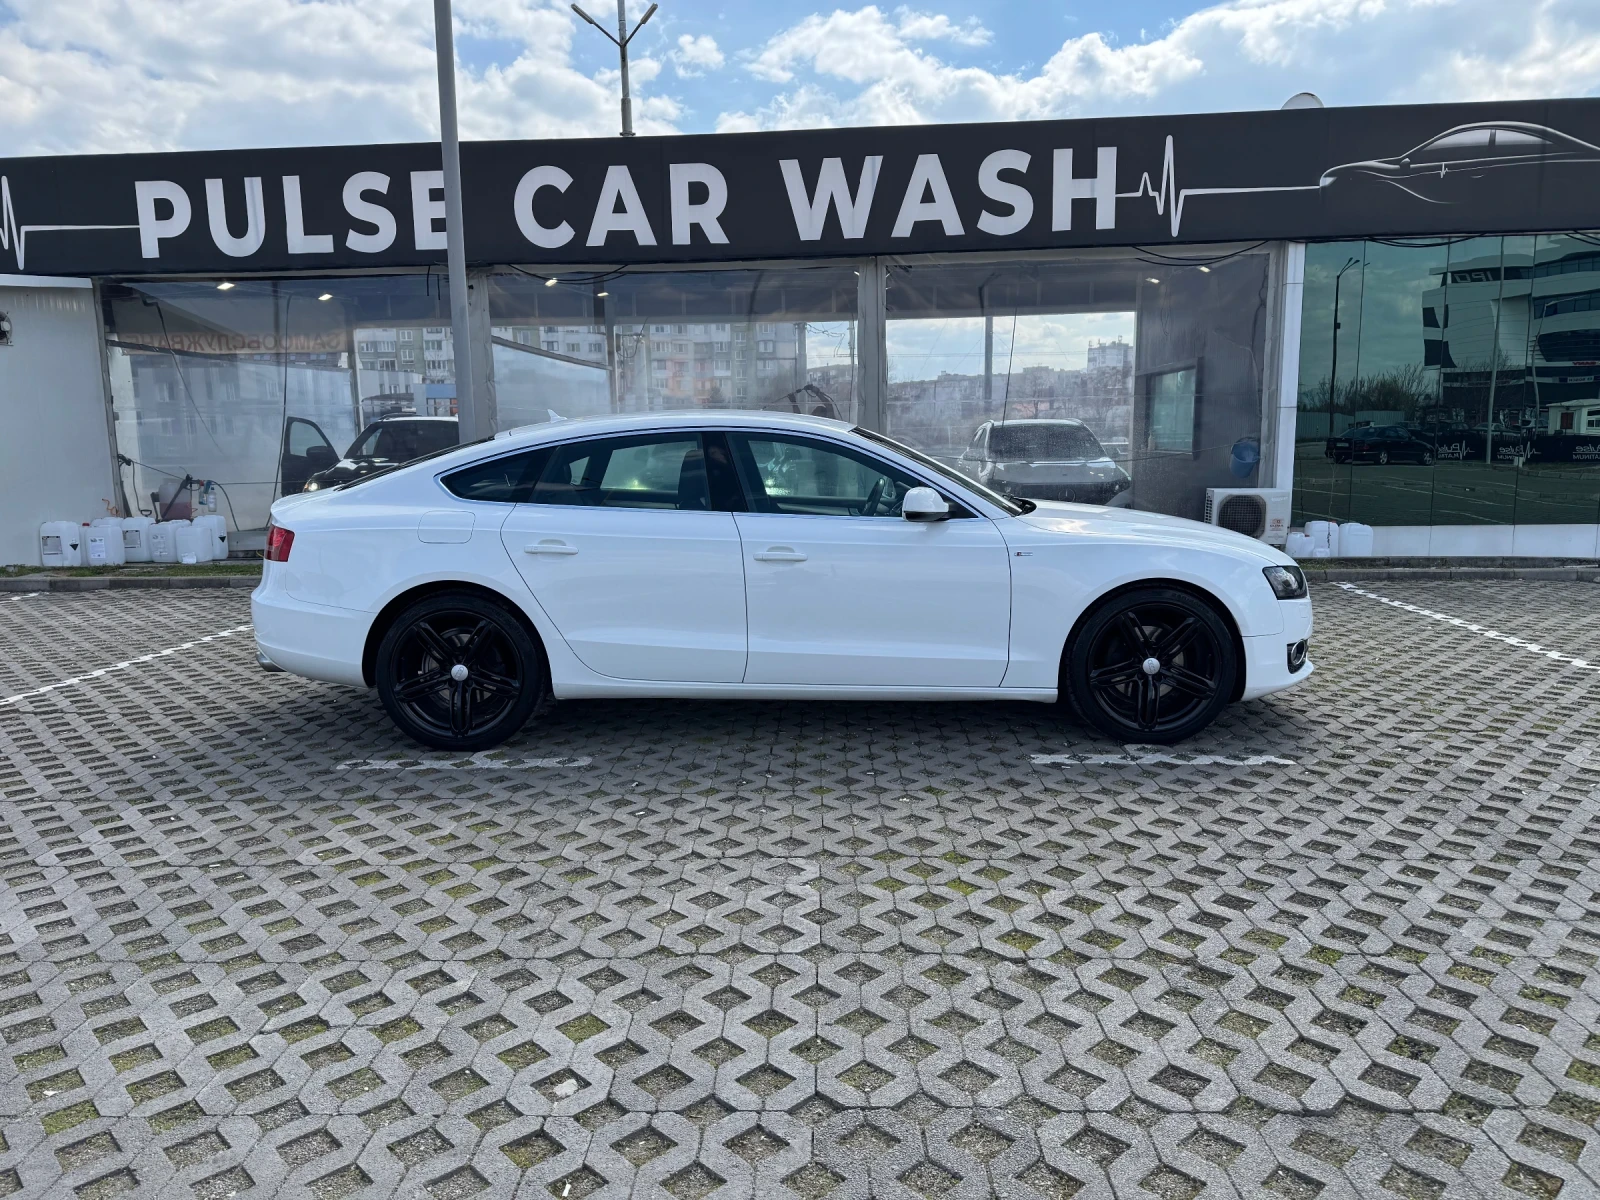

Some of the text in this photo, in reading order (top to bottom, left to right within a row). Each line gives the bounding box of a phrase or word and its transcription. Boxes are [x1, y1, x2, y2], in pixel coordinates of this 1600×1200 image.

[135, 146, 1117, 259] PULSE CAR WASH
